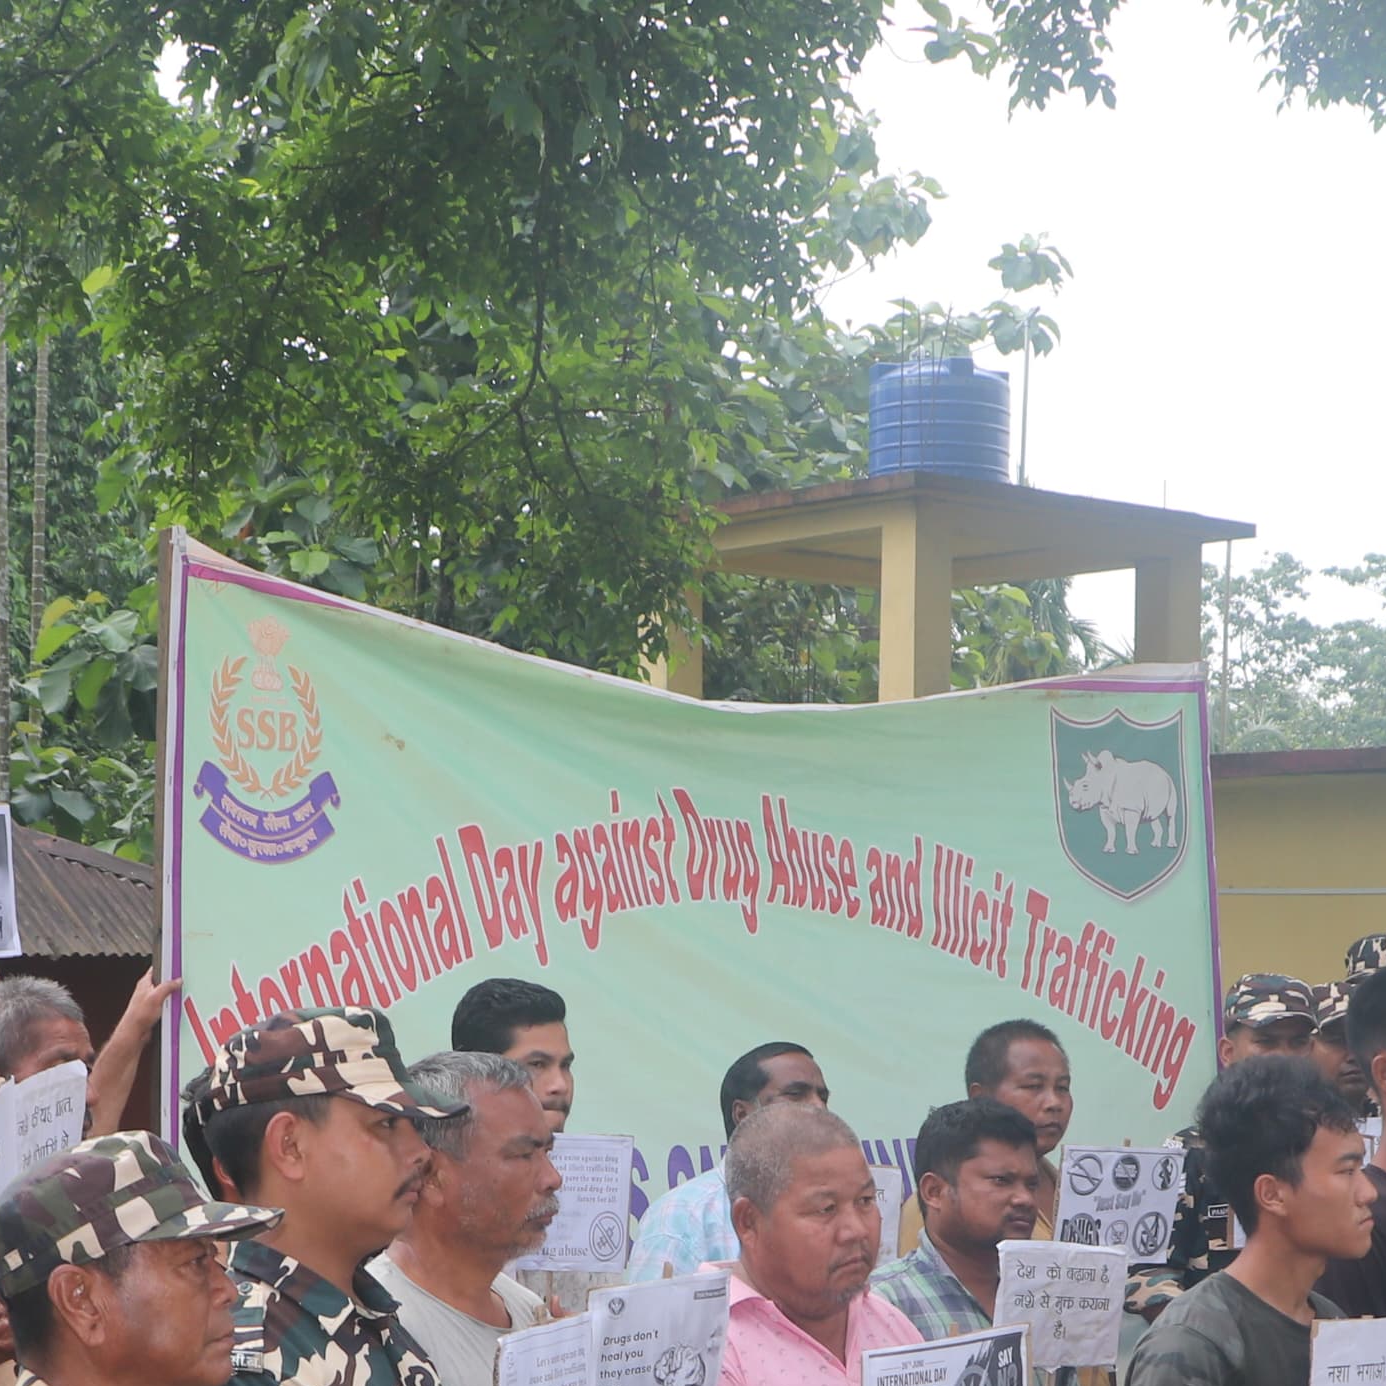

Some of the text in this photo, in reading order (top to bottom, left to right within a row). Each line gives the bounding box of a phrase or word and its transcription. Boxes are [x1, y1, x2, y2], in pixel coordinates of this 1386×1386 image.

[237, 708, 297, 752] SSB
[458, 824, 548, 967] Day
[555, 787, 682, 950] against
[673, 788, 760, 935] Drug
[763, 794, 861, 920] Abuse
[866, 834, 925, 939] and
[932, 842, 1015, 979] Illicit
[1020, 887, 1196, 1111] Trafficking
[558, 1244, 588, 1257] abuse
[1016, 1260, 1036, 1279] देश
[1046, 1262, 1062, 1279] को
[1014, 1290, 1035, 1310] नशे
[1040, 1290, 1051, 1309] से
[1078, 1296, 1110, 1312] कराना
[603, 1334, 631, 1346] Drugs
[601, 1350, 644, 1363] heal you
[998, 1346, 1013, 1367] SAY
[600, 1365, 652, 1380] they erase
[934, 1367, 948, 1383] DAY
[1327, 1364, 1351, 1384] नशा
